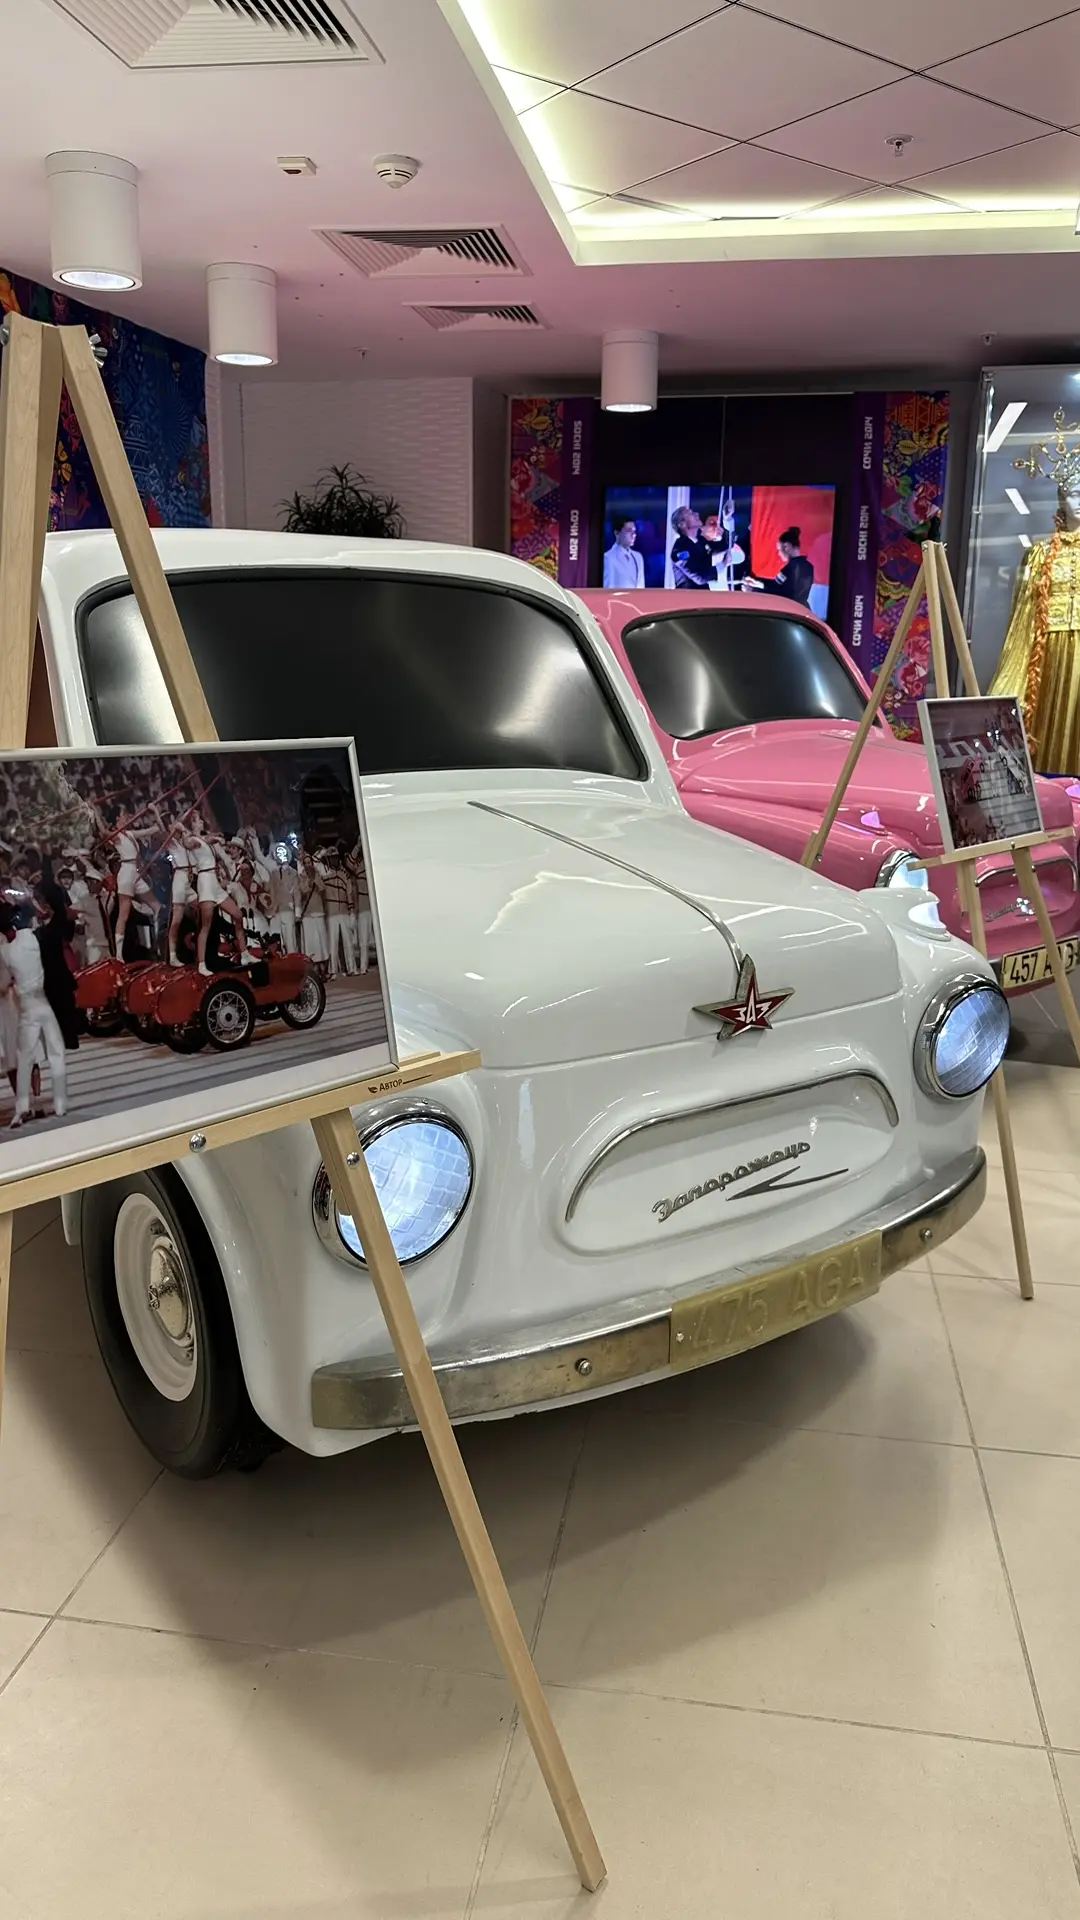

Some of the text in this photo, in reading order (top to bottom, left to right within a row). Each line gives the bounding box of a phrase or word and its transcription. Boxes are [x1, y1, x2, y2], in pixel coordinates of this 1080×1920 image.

[572, 420, 582, 475] SOCHI 2014
[864, 416, 873, 440] 2014
[569, 510, 580, 561] СОЧИ 2014
[857, 505, 869, 561] SOCHI 2014
[852, 595, 864, 647] СОЧИ 2014
[1010, 952, 1038, 984] 457
[732, 988, 772, 1024] ЗАЗ
[693, 1246, 865, 1350] 475 AGA
